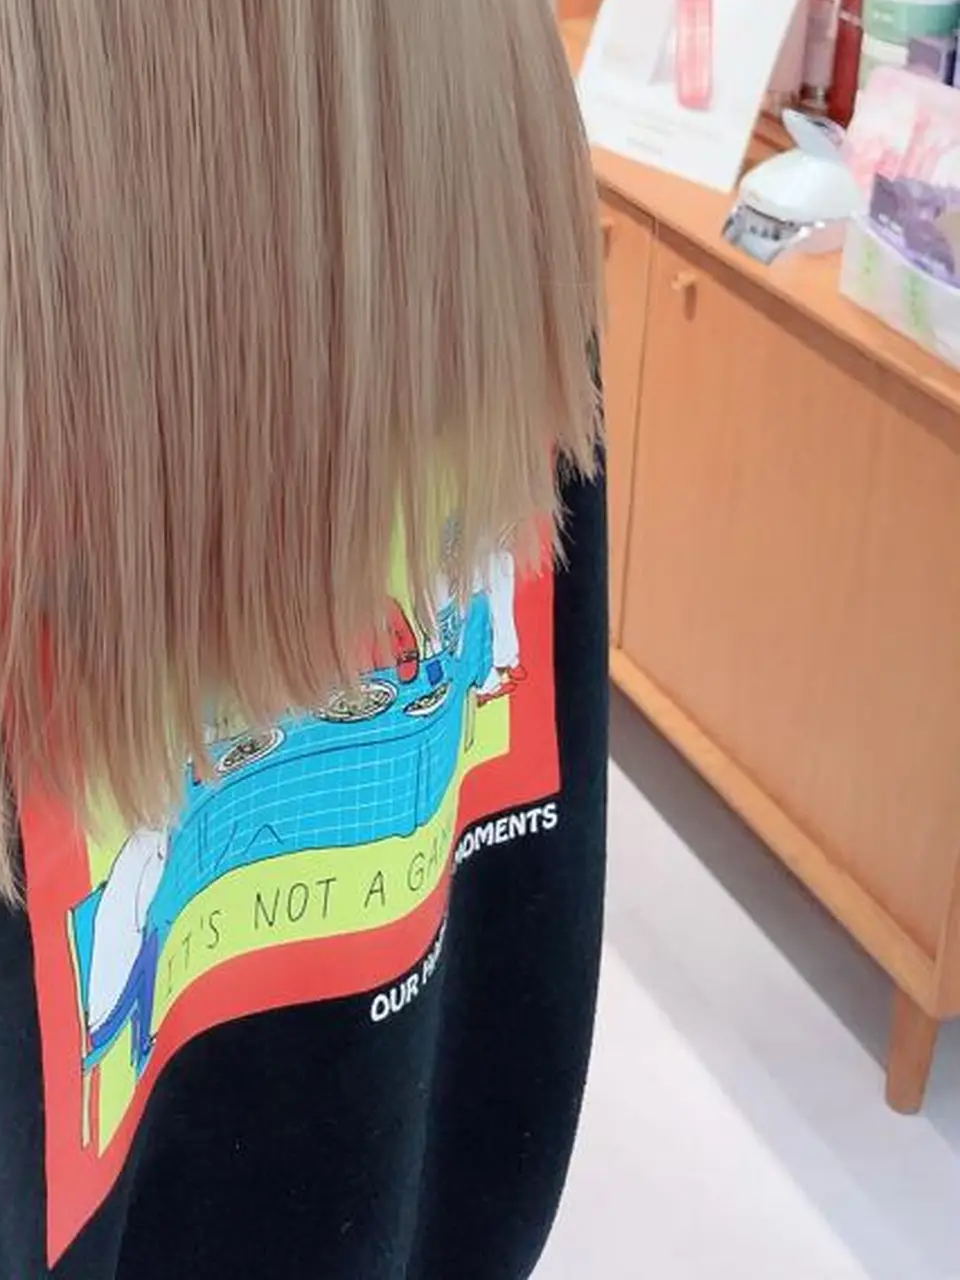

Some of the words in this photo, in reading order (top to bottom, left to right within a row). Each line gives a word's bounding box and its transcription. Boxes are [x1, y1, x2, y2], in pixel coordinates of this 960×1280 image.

[253, 877, 337, 930] NOT
[364, 869, 386, 907] A
[370, 972, 419, 1021] OUR
